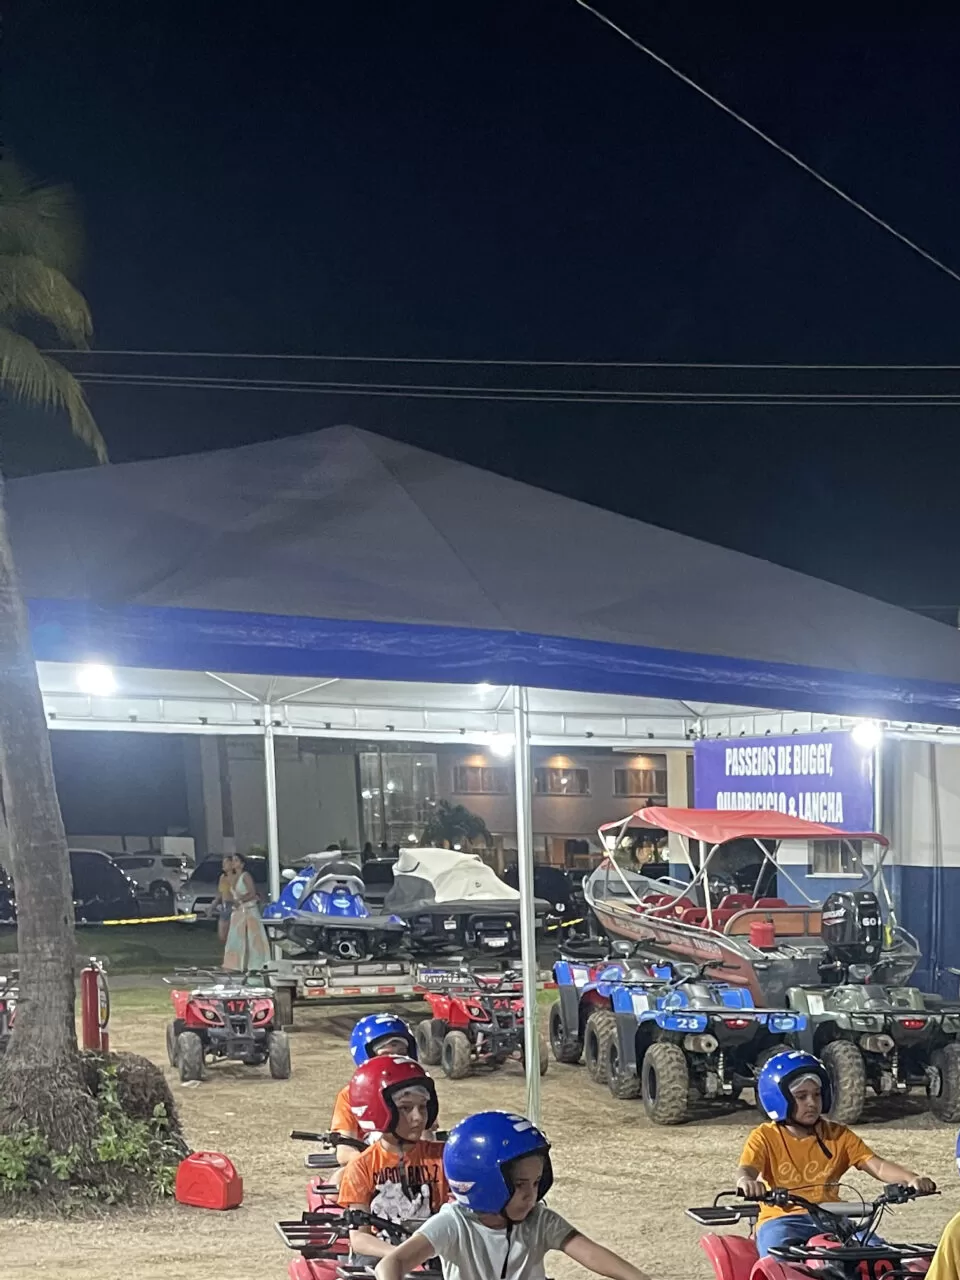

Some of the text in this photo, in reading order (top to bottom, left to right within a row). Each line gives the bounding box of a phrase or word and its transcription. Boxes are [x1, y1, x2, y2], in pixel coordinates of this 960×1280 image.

[725, 743, 833, 777] PASSEIOS DE BUGGY,
[788, 796, 798, 818] &
[798, 792, 844, 823] LANCHA
[862, 917, 877, 927] 60
[227, 1001, 246, 1012] 17
[493, 999, 509, 1009] 21
[676, 1018, 699, 1030] 28
